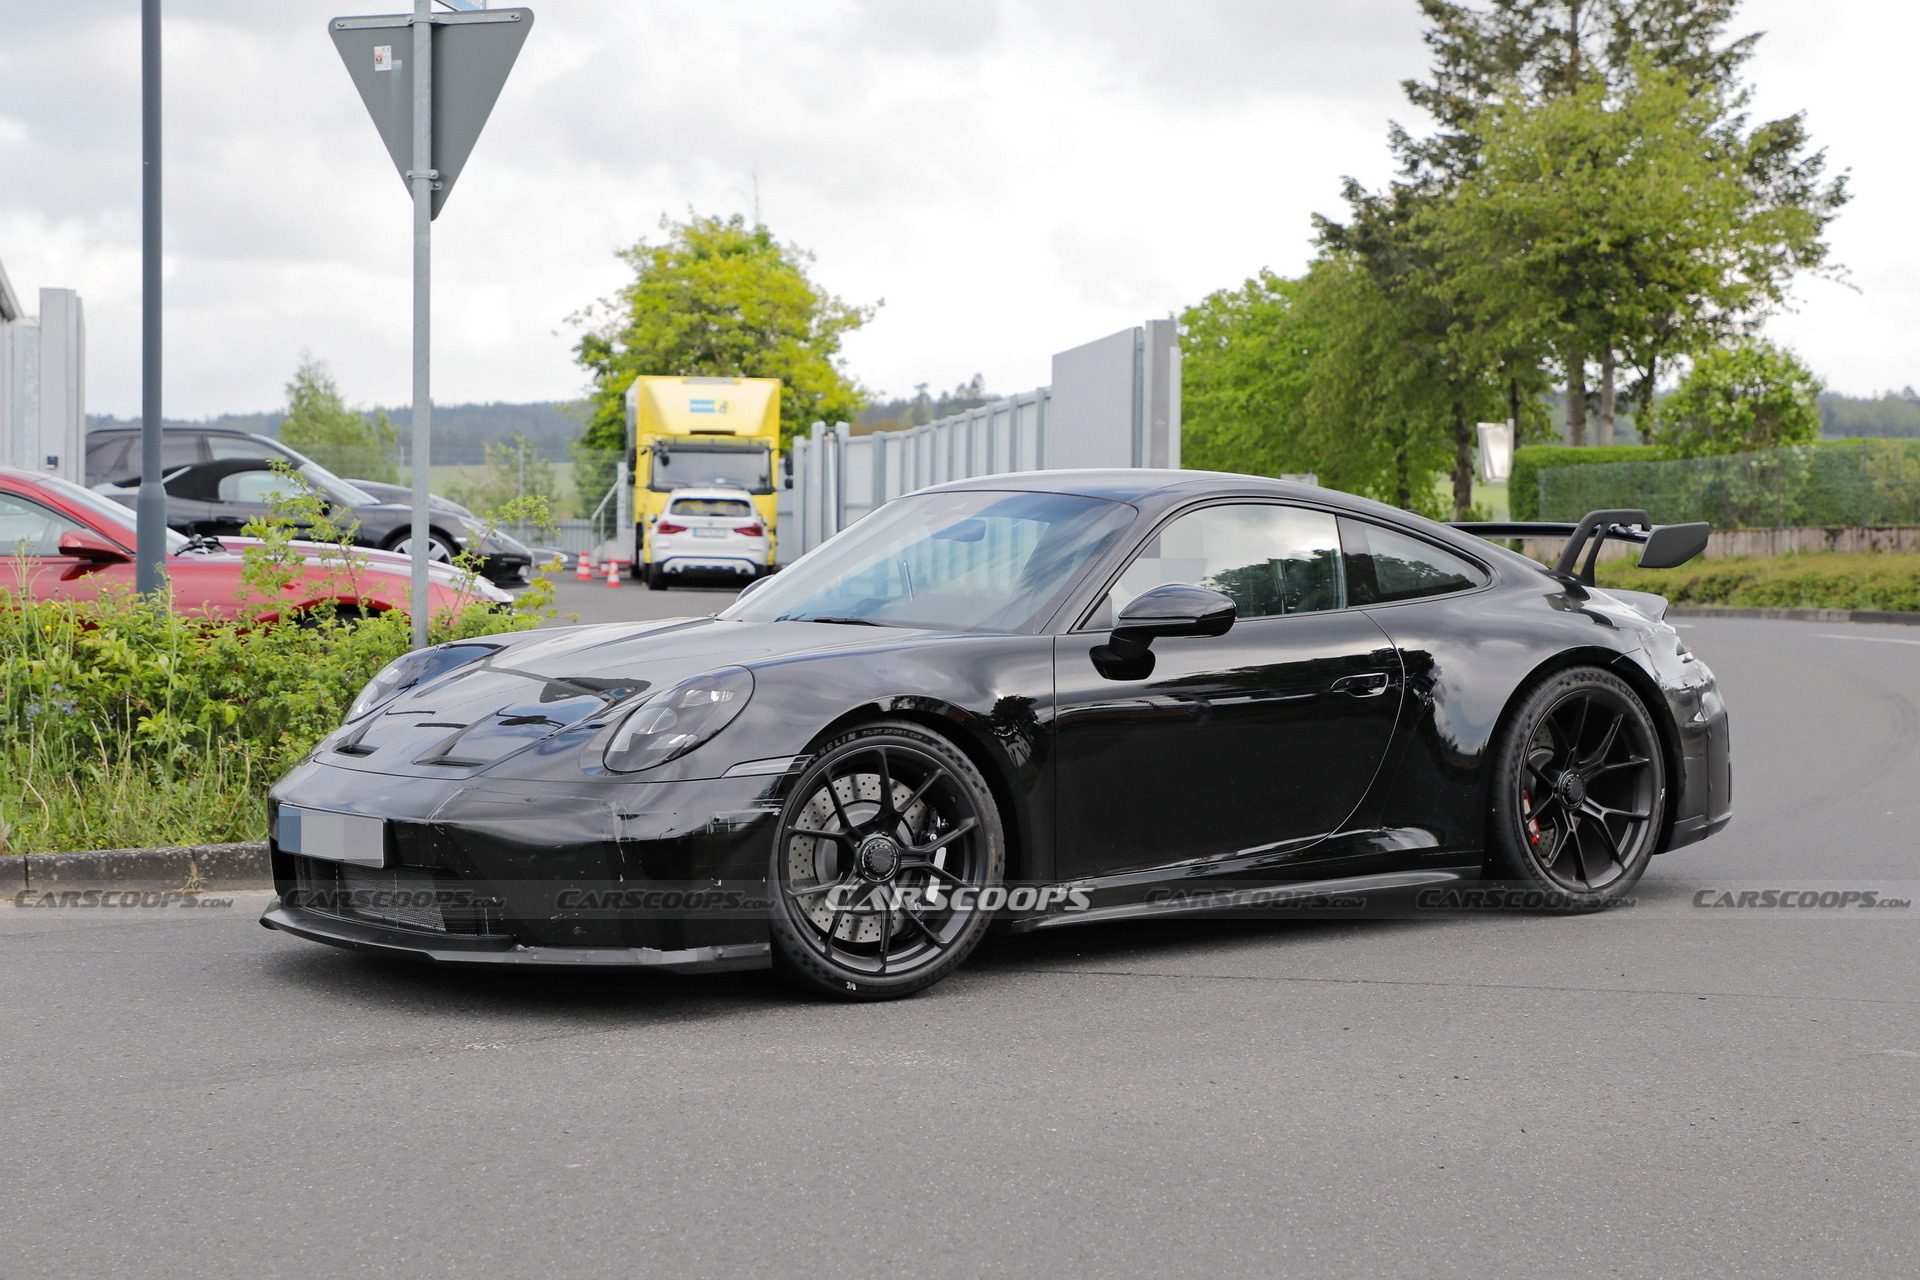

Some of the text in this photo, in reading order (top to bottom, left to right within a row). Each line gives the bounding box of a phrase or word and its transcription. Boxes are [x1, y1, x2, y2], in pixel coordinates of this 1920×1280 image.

[1620, 685, 1652, 726] MICHELIN
[806, 732, 857, 766] ICHELIN
[862, 728, 882, 736] PILOT
[884, 728, 907, 736] SPORT
[908, 732, 923, 740] CUP
